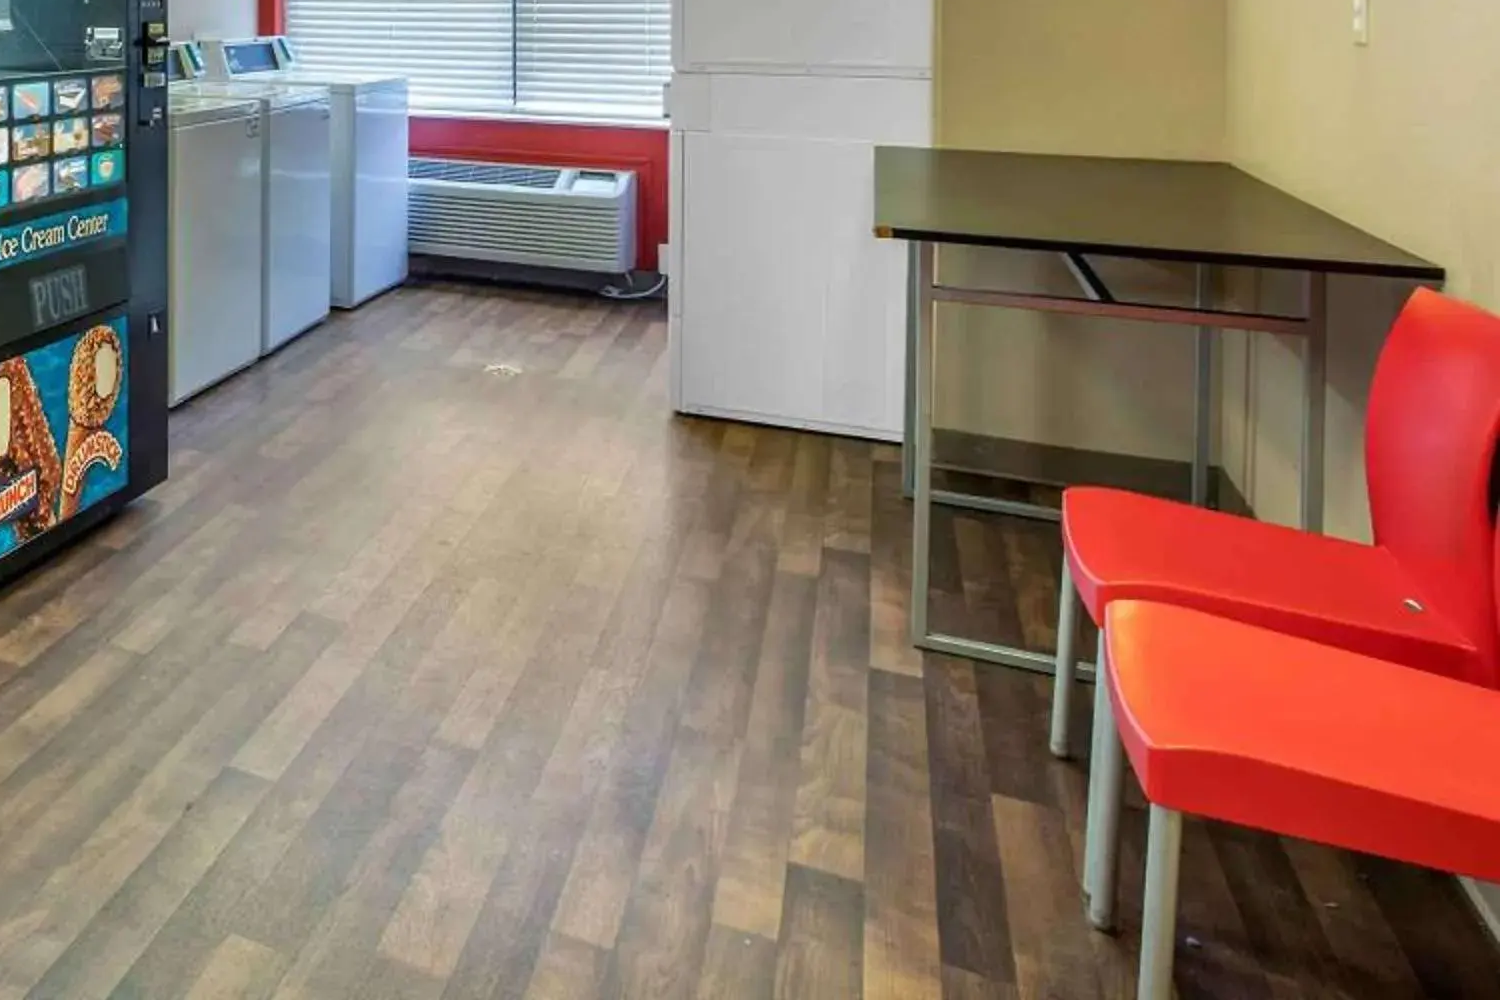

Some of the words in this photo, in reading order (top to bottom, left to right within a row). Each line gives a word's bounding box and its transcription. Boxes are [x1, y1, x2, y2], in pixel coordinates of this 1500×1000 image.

[21, 223, 65, 254] Cream
[67, 213, 109, 241] Center
[30, 265, 88, 327] PUSH
